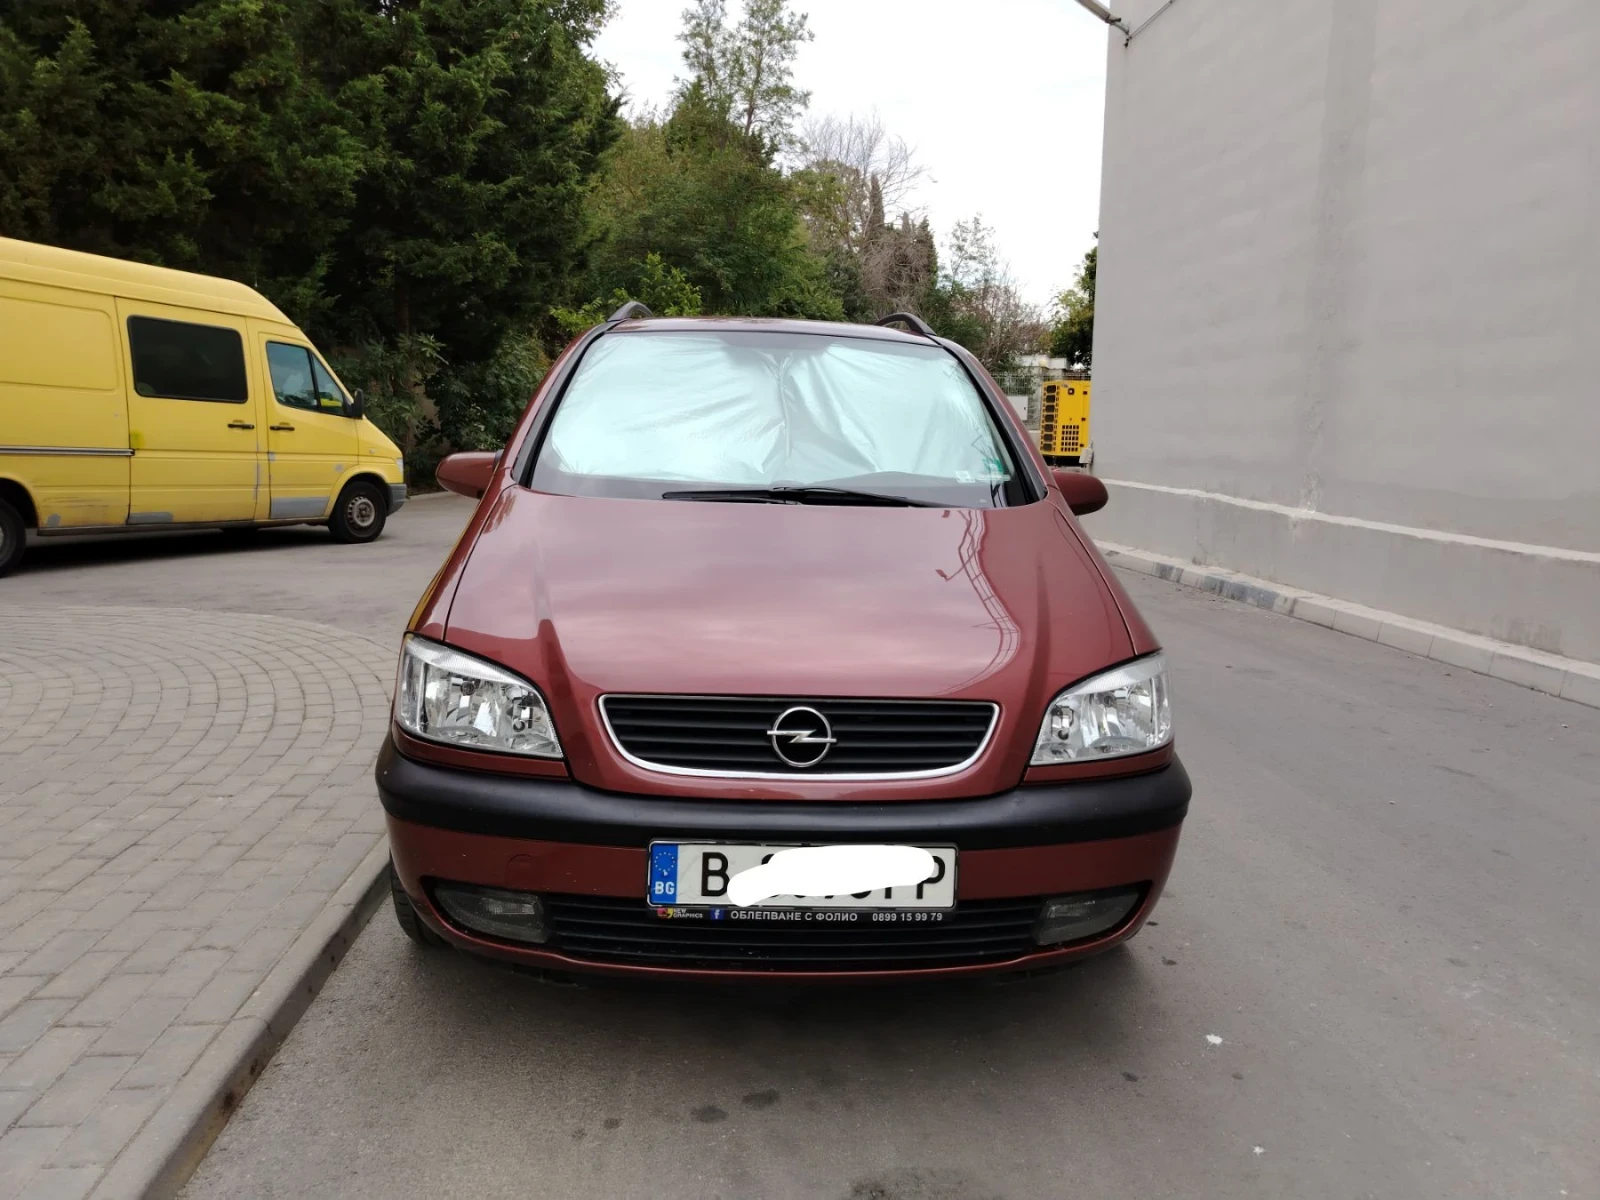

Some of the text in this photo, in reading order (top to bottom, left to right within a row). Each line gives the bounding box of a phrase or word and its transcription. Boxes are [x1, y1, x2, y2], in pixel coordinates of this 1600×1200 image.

[654, 881, 675, 895] BG
[730, 910, 802, 921] ОБЛЕПВАНЕ
[815, 912, 858, 921] ФОЛИО
[872, 912, 943, 922] 0899 15 99 79
